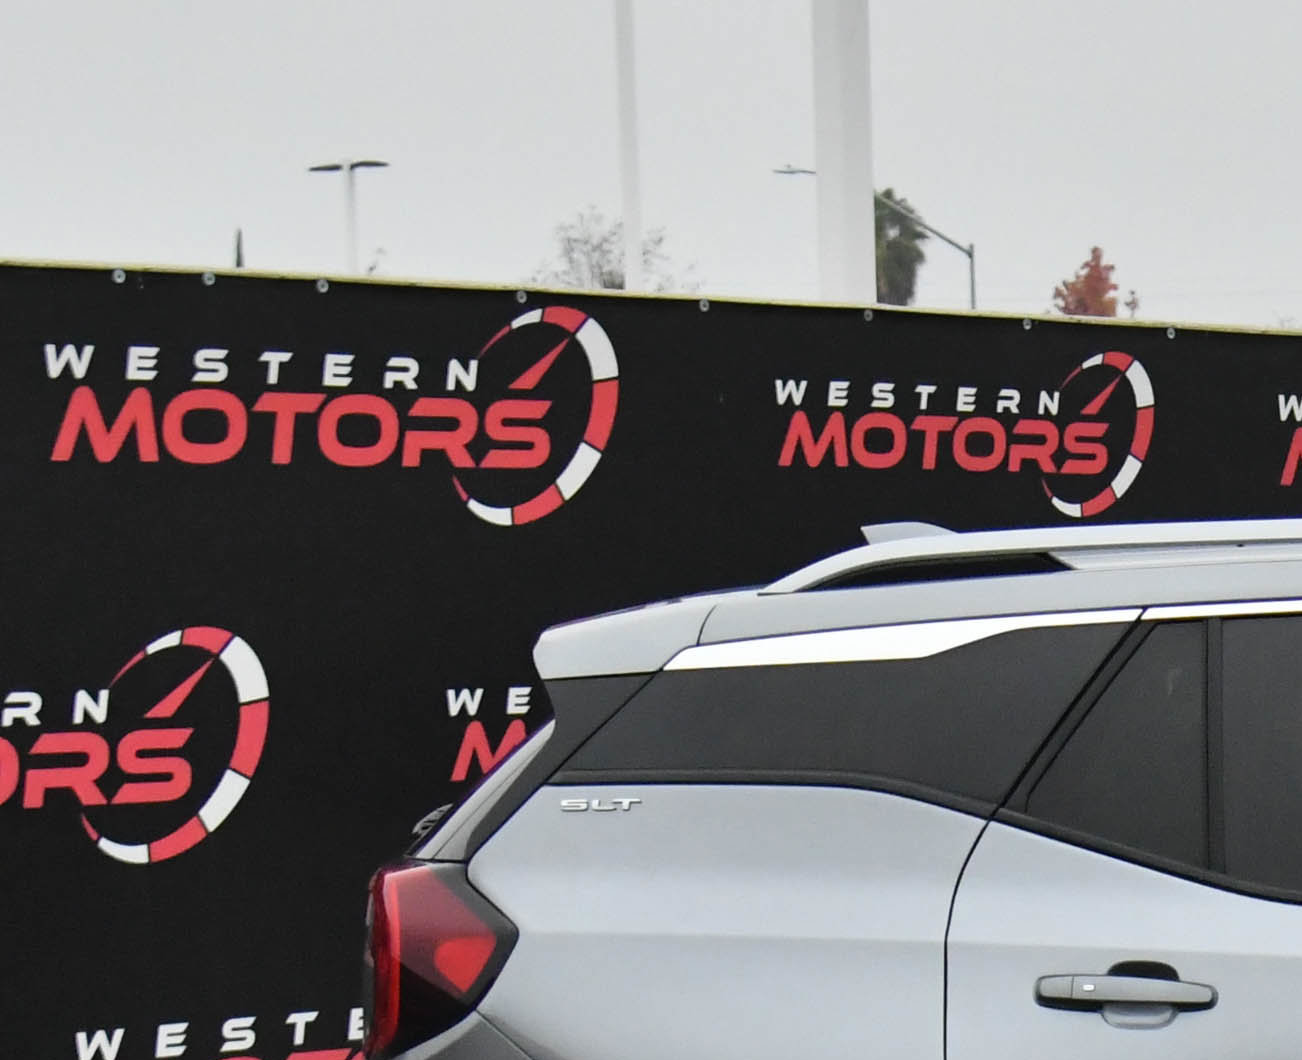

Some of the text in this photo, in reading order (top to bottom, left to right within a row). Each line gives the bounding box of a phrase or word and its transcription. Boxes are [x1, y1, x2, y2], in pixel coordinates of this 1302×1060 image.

[45, 343, 479, 392] WESTERN
[774, 379, 1060, 416] WESTERN
[51, 385, 552, 469] MOTORS
[778, 410, 1109, 475] MOTORS
[0, 727, 195, 809] RS
[560, 798, 642, 812] SLT
